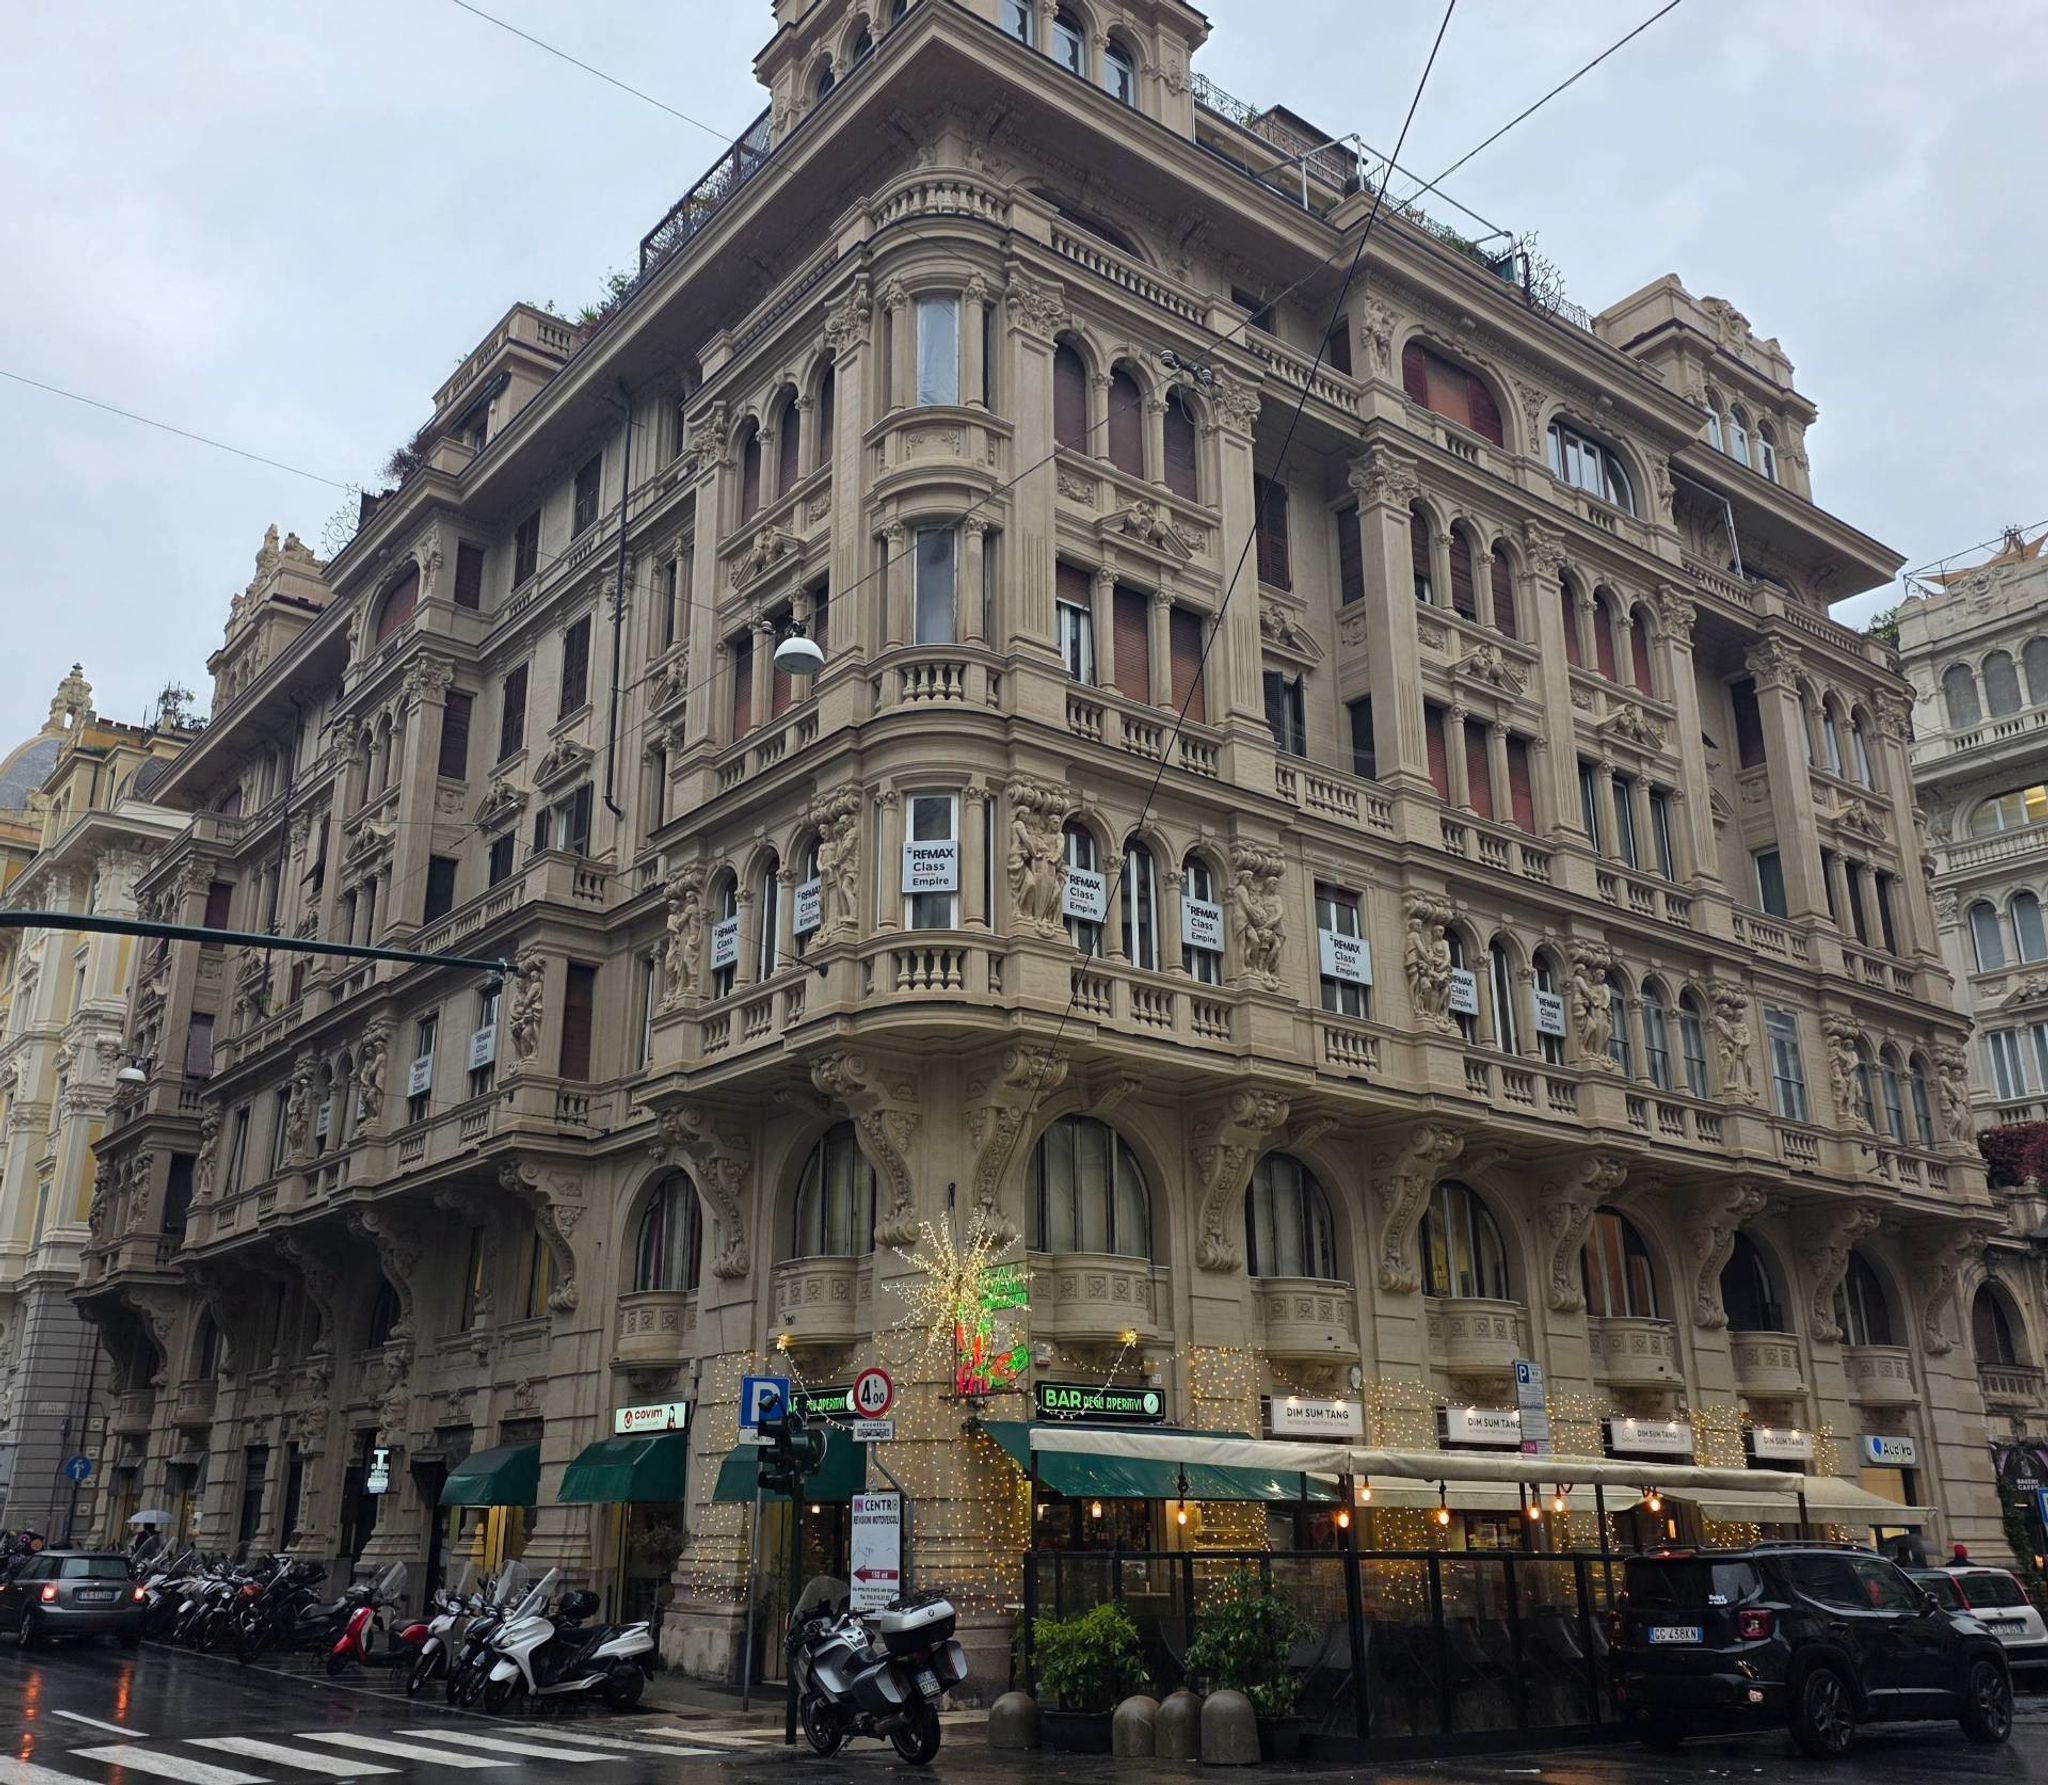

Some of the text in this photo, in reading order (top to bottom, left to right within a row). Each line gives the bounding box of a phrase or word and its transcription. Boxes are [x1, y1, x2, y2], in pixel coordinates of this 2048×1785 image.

[913, 848, 955, 860] REMAX
[913, 862, 946, 872] Class
[912, 876, 949, 887] Empire
[1070, 887, 1095, 901] Class
[1070, 901, 1098, 915] Empire
[1191, 918, 1213, 931] Class
[1191, 931, 1217, 944] Empire
[1334, 951, 1356, 964] Class
[1519, 1365, 1527, 1382] P
[750, 1381, 781, 1422] P
[1046, 1389, 1082, 1408] BAR
[1106, 1397, 1142, 1411] APERITIVI
[1286, 1407, 1349, 1420] DIM SUM TANG
[1468, 1417, 1521, 1430] DIM SUM TANG
[1661, 1430, 1677, 1439] TANG
[865, 1499, 899, 1511] CENTRO
